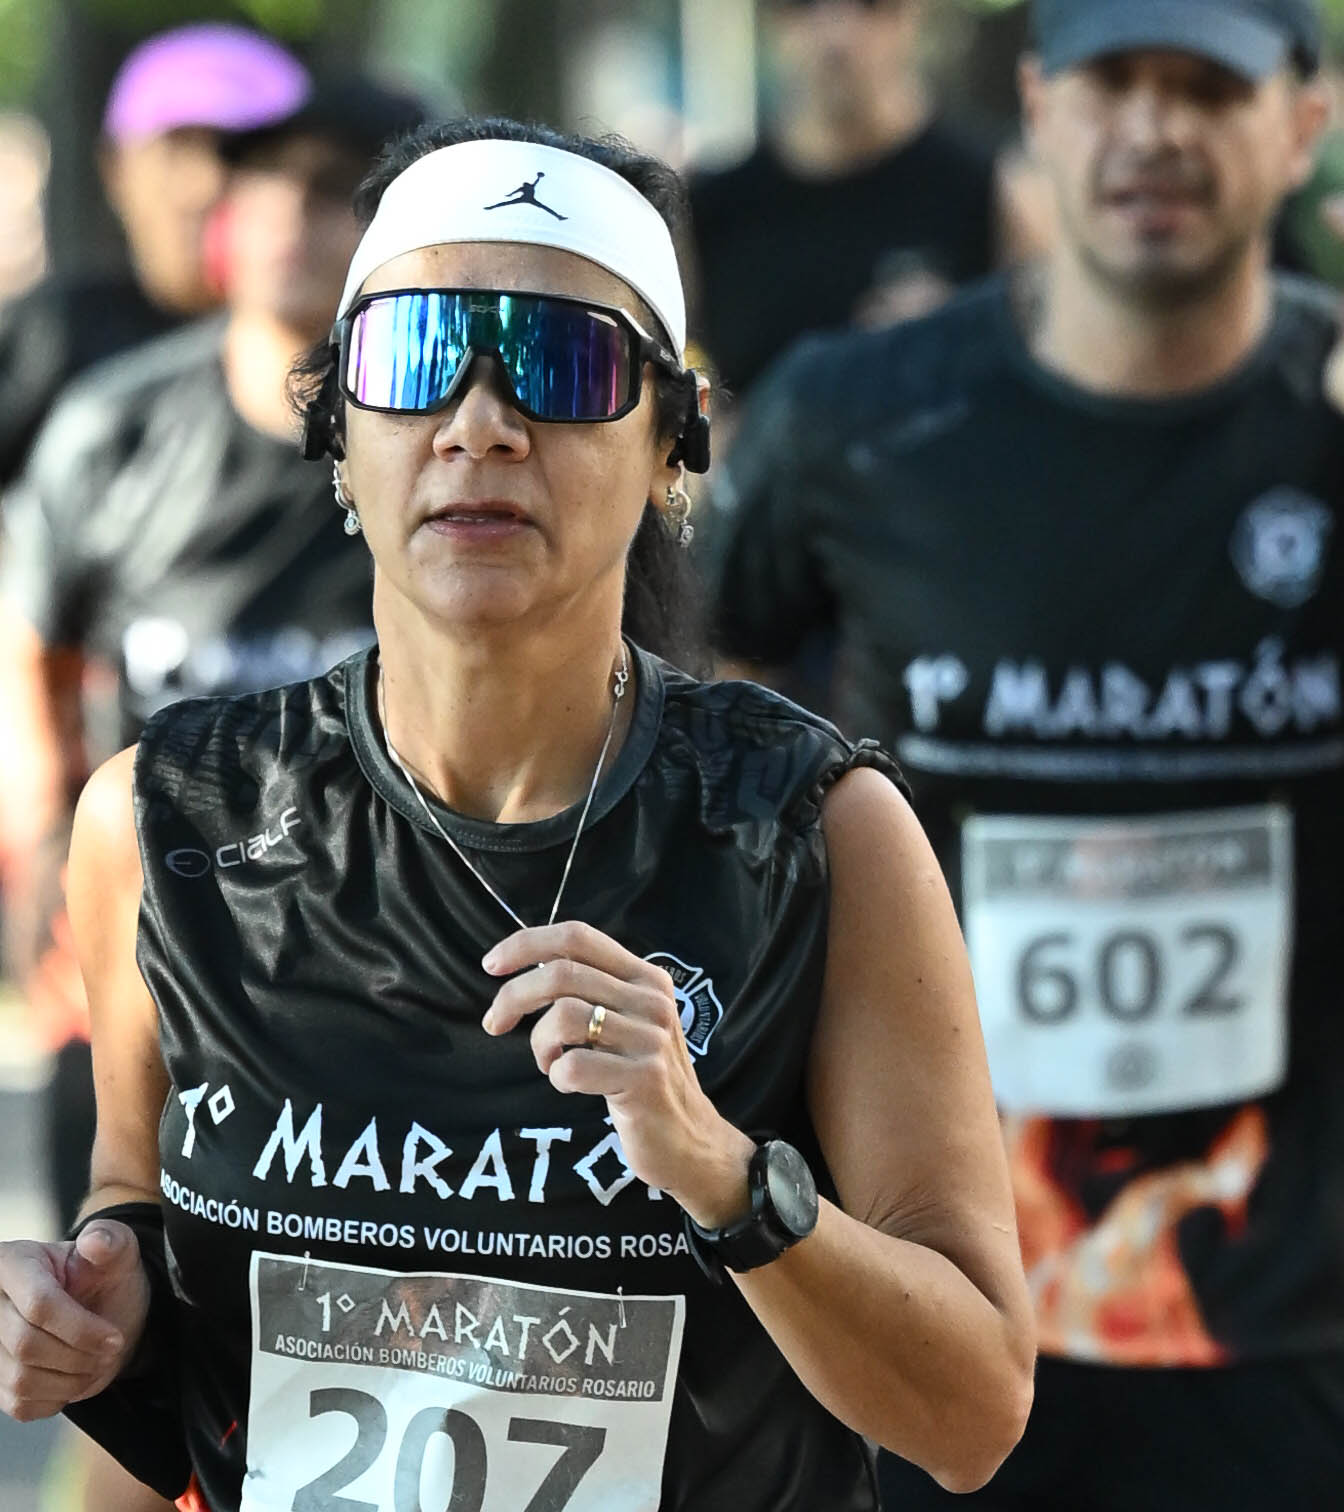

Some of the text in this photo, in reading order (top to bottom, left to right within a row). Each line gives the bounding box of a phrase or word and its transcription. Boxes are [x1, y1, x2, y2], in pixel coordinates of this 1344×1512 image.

[984, 637, 1341, 737] MARATÓN
[1016, 921, 1244, 1026] 602
[253, 1097, 663, 1207] MARATÓ
[267, 1210, 416, 1249] BOMBEROS
[424, 1227, 612, 1259] VOLUNTARIOS
[275, 1334, 656, 1398] ASOCIACIÓN BOMBEROS VOLUNTARIOS ROSARIO
[373, 1297, 618, 1366] MARATÓN
